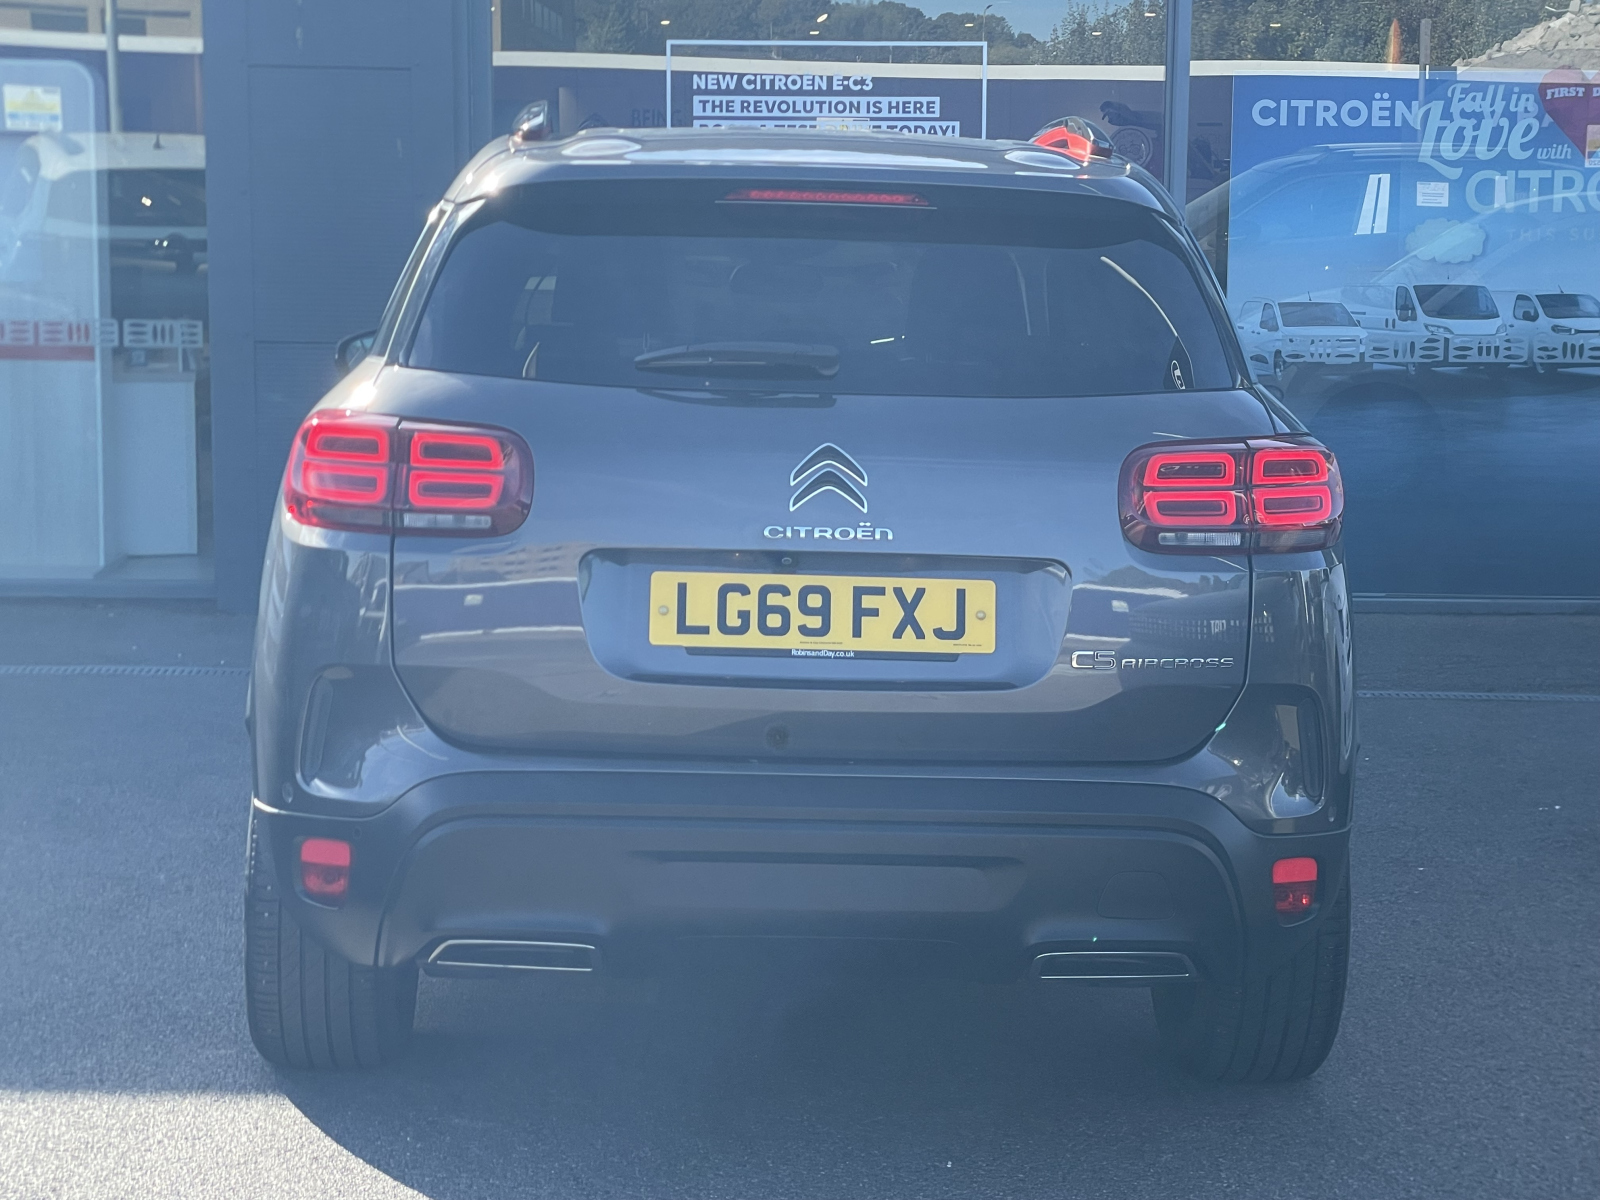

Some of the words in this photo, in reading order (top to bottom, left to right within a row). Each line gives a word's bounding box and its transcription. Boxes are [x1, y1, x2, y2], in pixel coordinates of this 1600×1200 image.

[693, 74, 738, 90] NEW
[1448, 83, 1506, 113] Fall
[1509, 87, 1536, 113] in
[1546, 86, 1585, 100] FIRST
[698, 100, 735, 114] THE
[740, 101, 861, 115] REVOLUTION
[866, 101, 883, 115] IS
[888, 101, 936, 115] HERE
[1251, 92, 1421, 127] CITROËN
[1417, 100, 1541, 180] Love
[1537, 143, 1572, 160] with
[676, 582, 832, 638] LG69
[852, 586, 967, 640] FXJ
[791, 648, 855, 659] RobinsandDay.co.uk
[1071, 650, 1117, 670] C5
[1121, 657, 1235, 670] AIRCROSS
